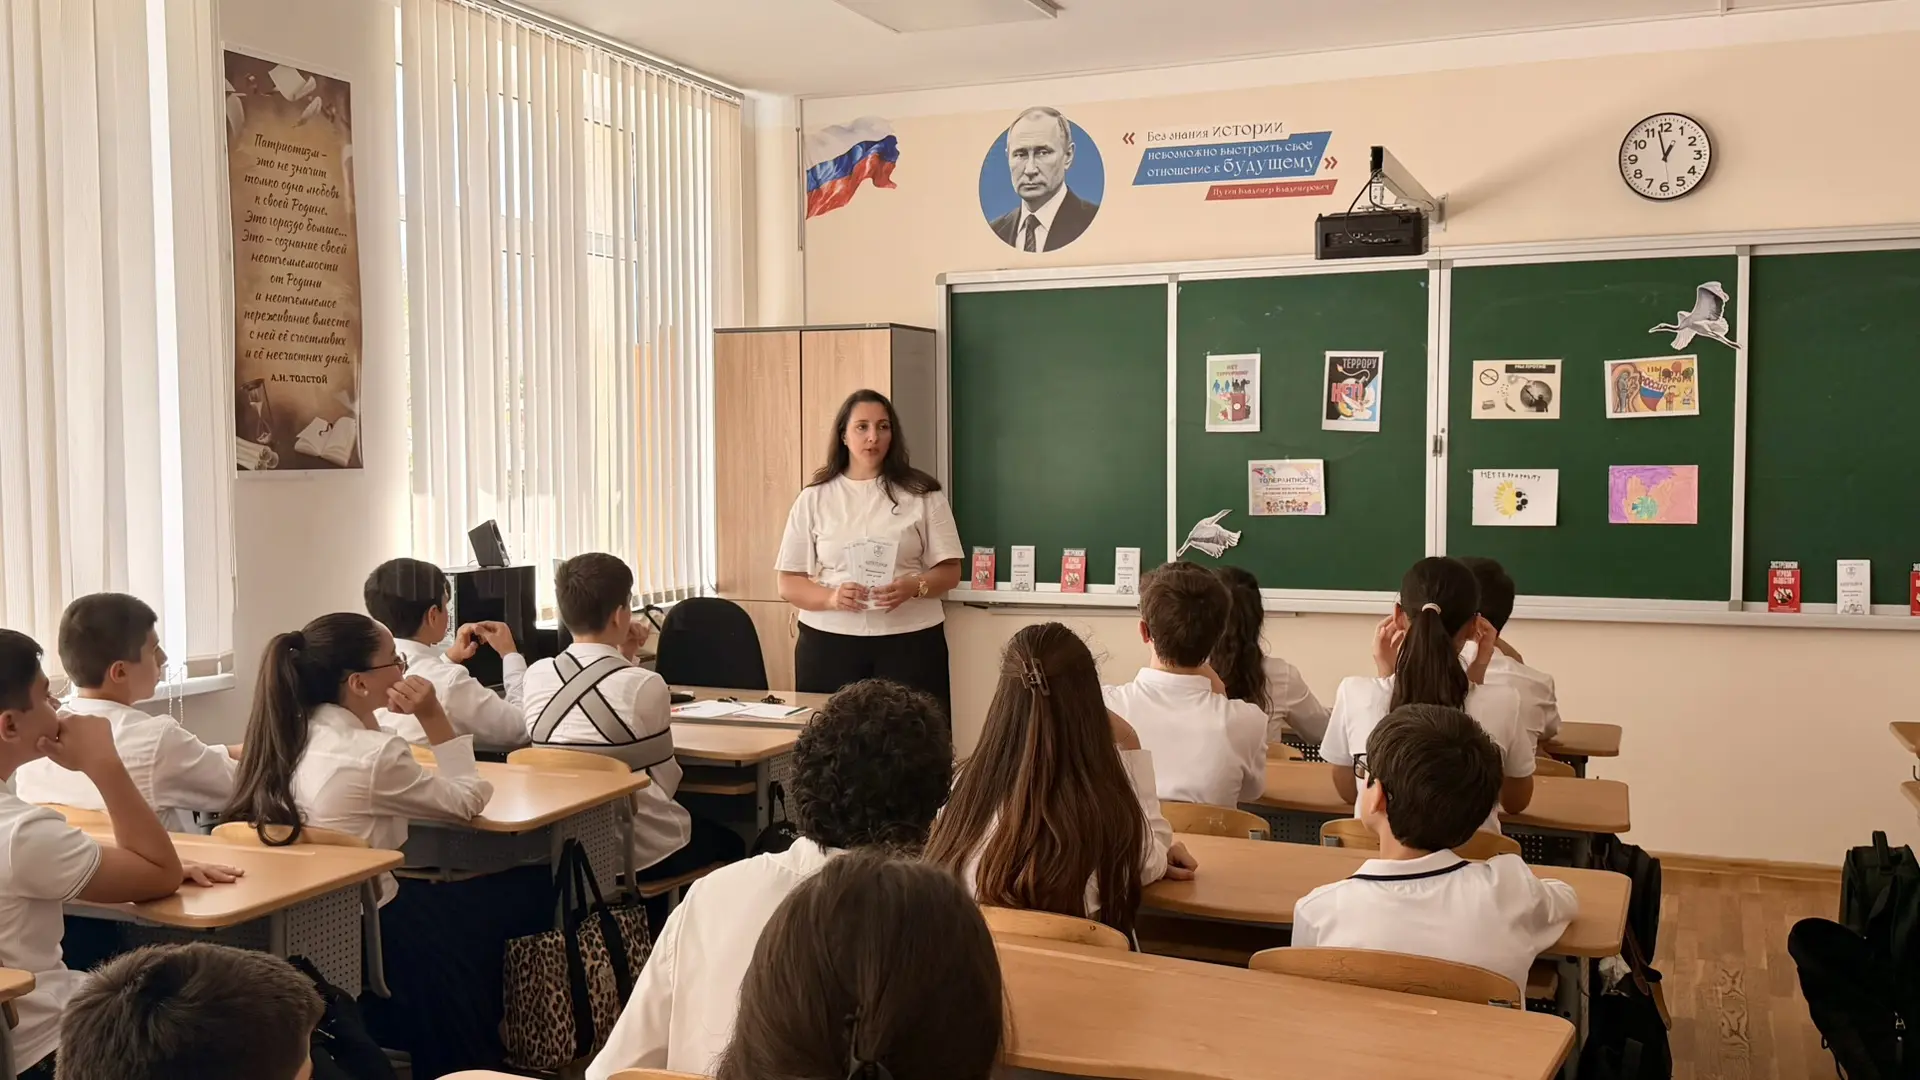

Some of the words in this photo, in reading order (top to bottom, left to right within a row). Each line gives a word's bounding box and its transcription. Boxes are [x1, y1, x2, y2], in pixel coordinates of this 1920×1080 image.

[1658, 122, 1673, 132] 12
[1679, 126, 1684, 136] 1
[1147, 131, 1167, 142] Без
[1169, 130, 1208, 140] знания
[1645, 128, 1655, 138] 11
[1633, 139, 1647, 150] 10
[1688, 136, 1697, 146] 2
[255, 134, 319, 161] Патриотизм
[1148, 148, 1218, 160] невозможно
[1220, 143, 1282, 156] выстроить
[1284, 141, 1313, 151] своё
[1628, 154, 1638, 165] 9
[1693, 150, 1703, 160] 3
[256, 157, 275, 168] это
[277, 161, 289, 171] не
[289, 164, 327, 178] значит
[1146, 165, 1210, 177] отношение
[1214, 165, 1220, 173] к
[1223, 156, 1317, 177] будущему
[1687, 165, 1697, 175] 4
[1633, 169, 1643, 179] 8
[244, 174, 278, 188] только
[281, 182, 303, 196] одна
[306, 183, 340, 199] любовь
[1645, 178, 1654, 189] 7
[1659, 182, 1670, 192] 6
[1676, 176, 1686, 187] 5
[254, 195, 261, 205] к
[263, 193, 289, 209] своей
[291, 198, 328, 217] Родине.
[244, 210, 267, 223] Это
[269, 217, 305, 235] гораздо
[306, 218, 348, 237] больше...
[241, 229, 264, 243] Это
[275, 237, 318, 252] сознание
[320, 239, 347, 254] своей
[251, 253, 339, 271] неотъемлемости
[270, 274, 284, 284] от
[255, 292, 262, 301] и
[265, 293, 337, 308] неотъемлемое
[243, 308, 310, 325] переживание
[312, 312, 350, 328] вместе
[249, 330, 255, 340] с
[256, 328, 276, 340] ней
[278, 330, 290, 341] её
[290, 332, 347, 346] счастливых
[245, 349, 251, 359] и
[254, 347, 265, 360] её
[266, 350, 324, 363] несчастных
[324, 353, 350, 368] дней.
[1342, 358, 1377, 369] ТЕРРОРУ
[289, 374, 328, 384] ТОЛСТОЙ
